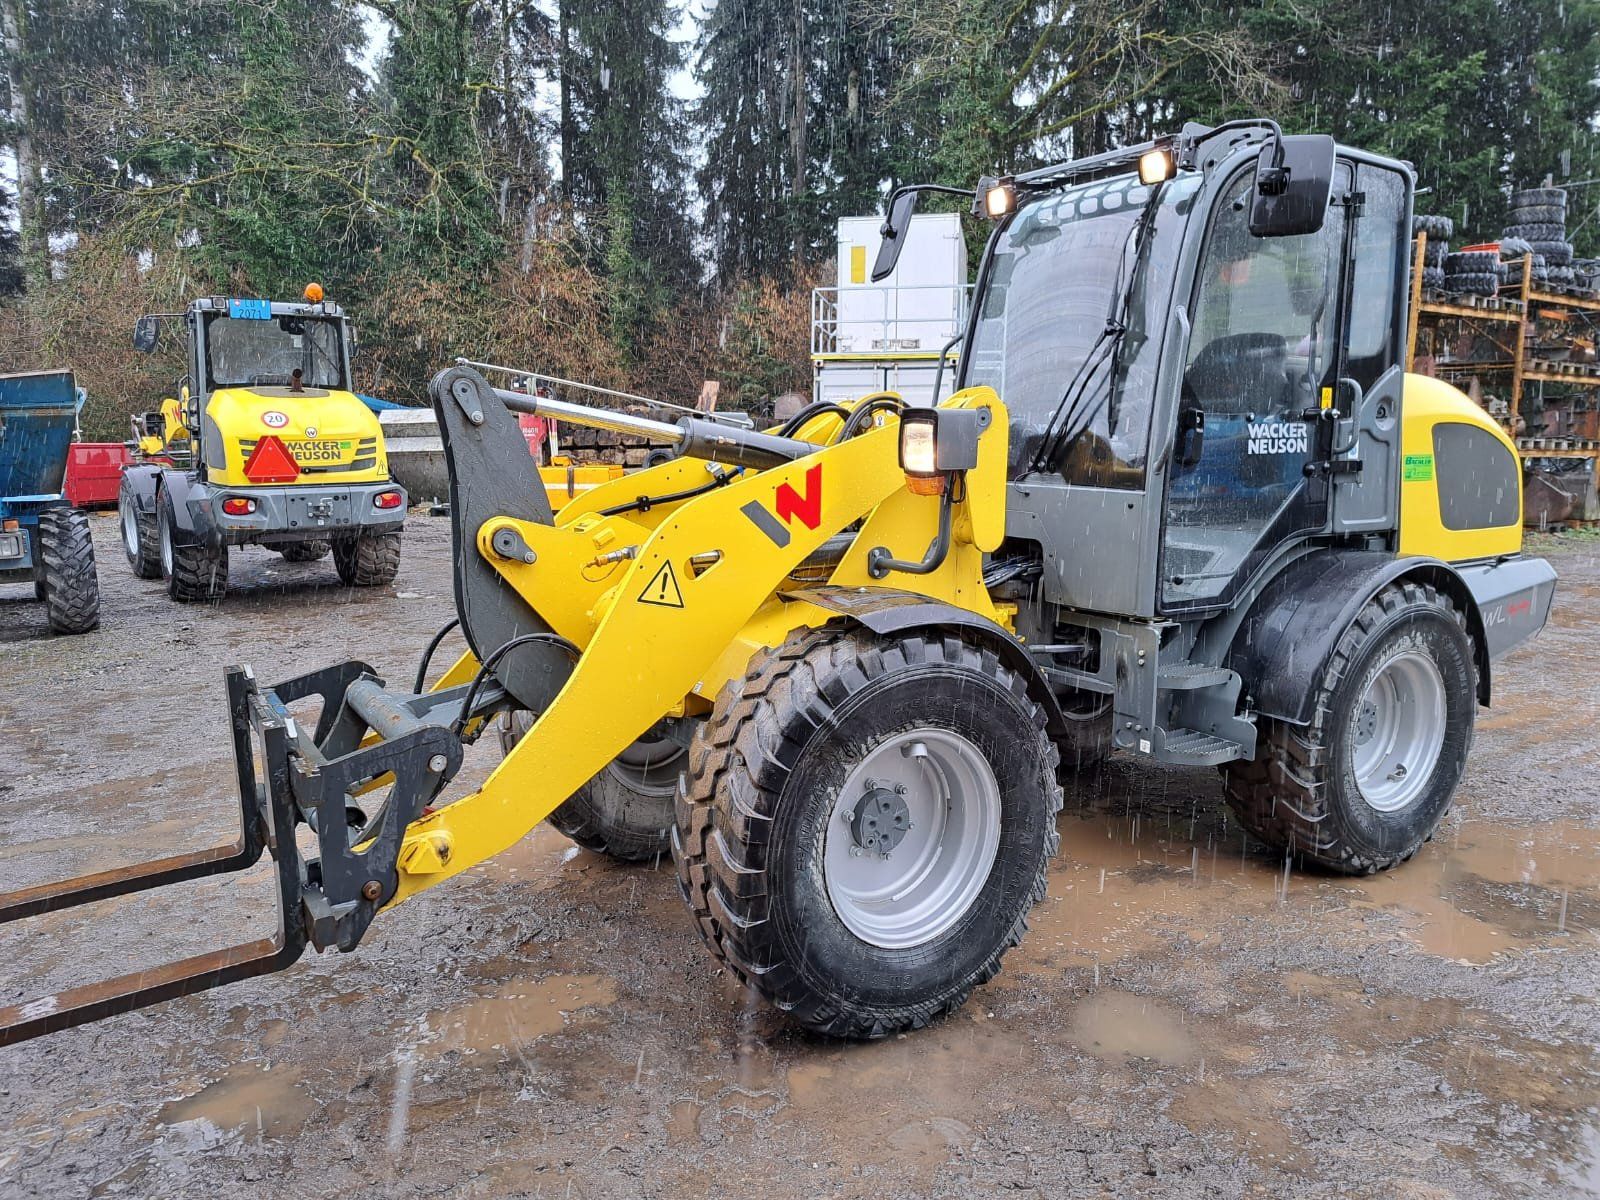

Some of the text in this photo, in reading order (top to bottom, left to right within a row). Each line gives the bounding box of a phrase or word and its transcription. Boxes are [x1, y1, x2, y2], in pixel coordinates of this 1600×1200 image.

[268, 415, 283, 423] 20
[1247, 423, 1308, 438] WACKER
[286, 441, 340, 451] WACKER
[1247, 438, 1308, 455] NEUSON
